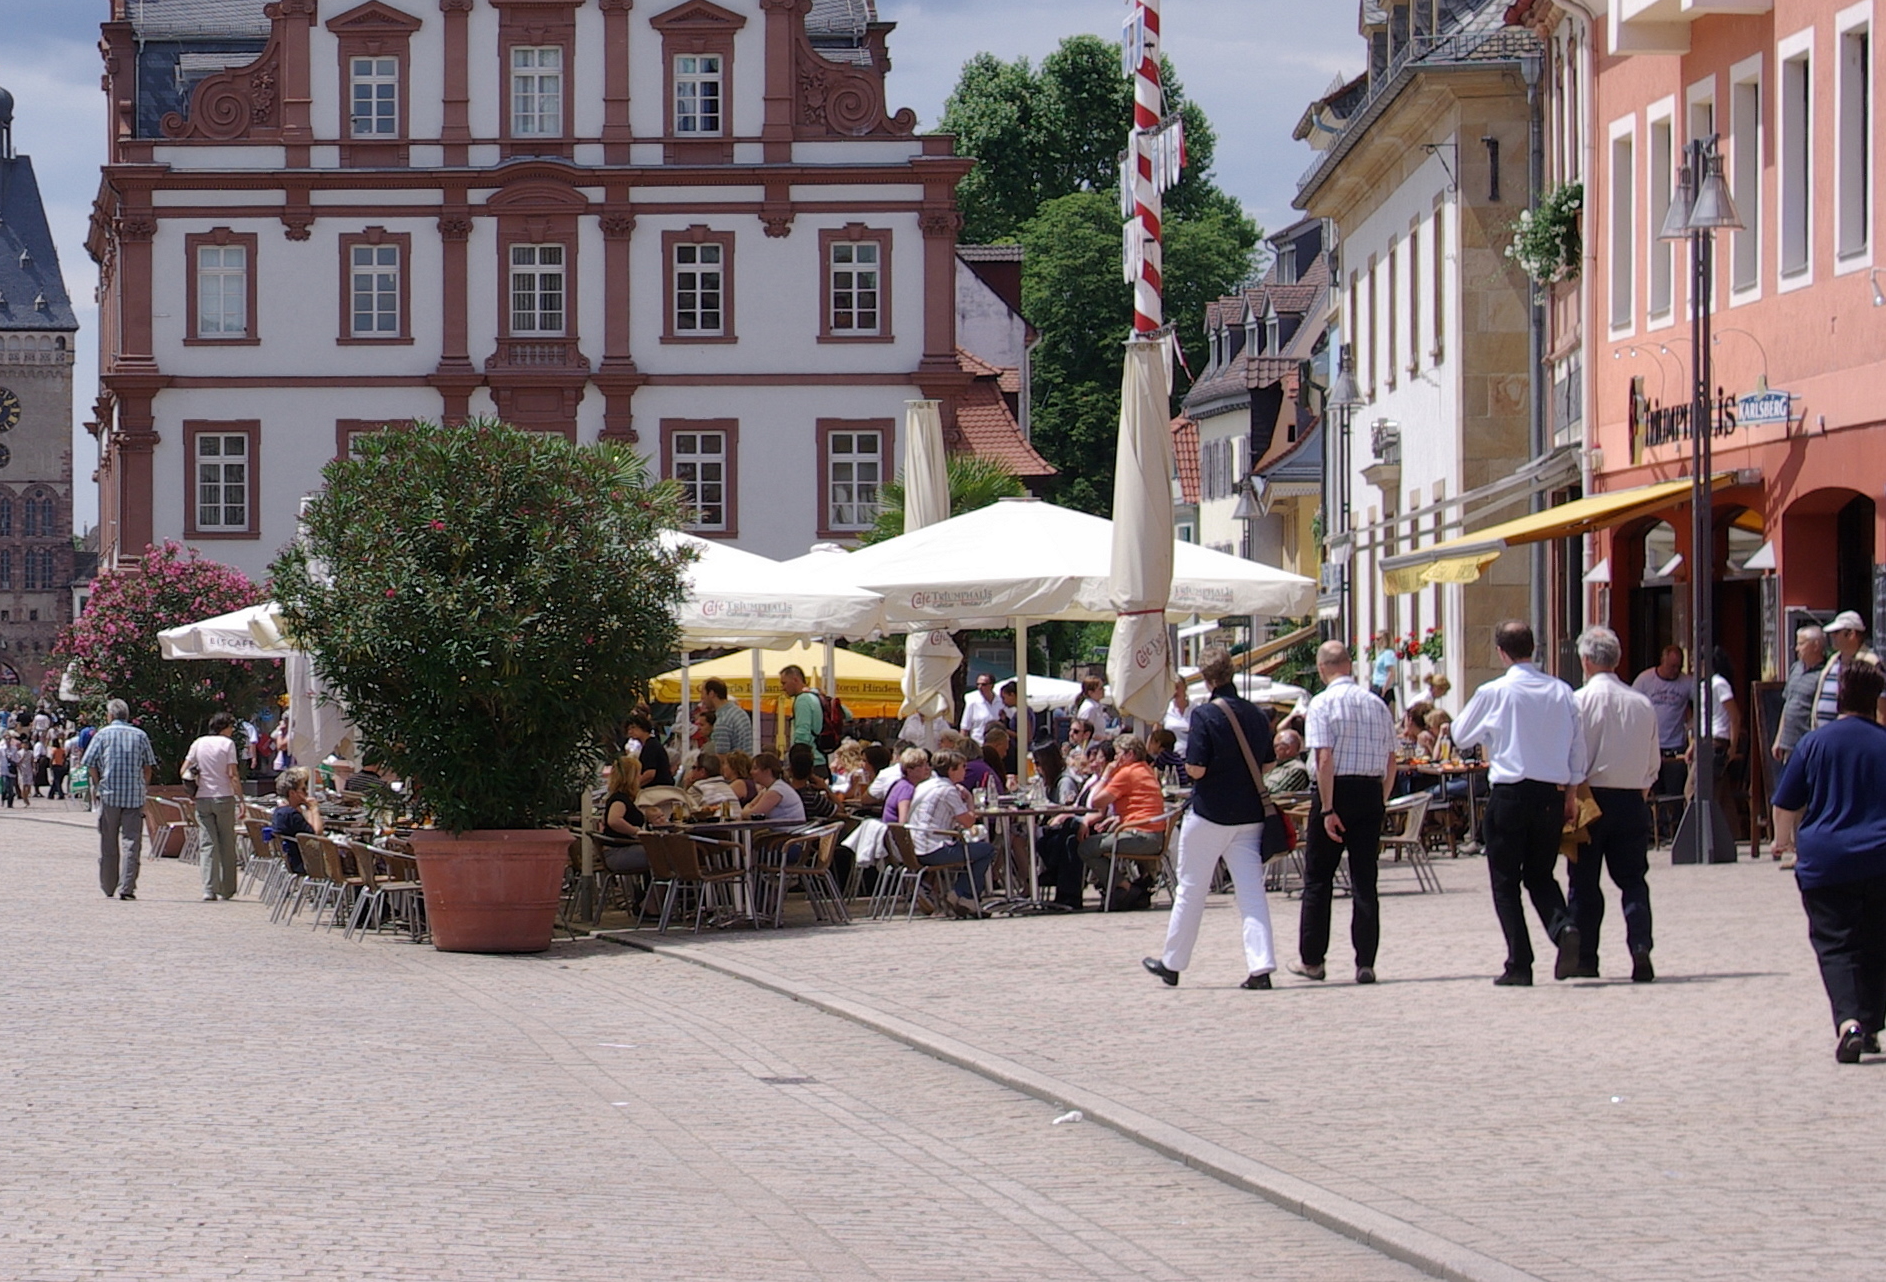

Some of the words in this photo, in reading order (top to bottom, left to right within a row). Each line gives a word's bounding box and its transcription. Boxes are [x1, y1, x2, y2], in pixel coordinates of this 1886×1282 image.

[1739, 397, 1787, 422] KARLSBERG
[702, 599, 725, 616] Café
[911, 590, 931, 609] Café
